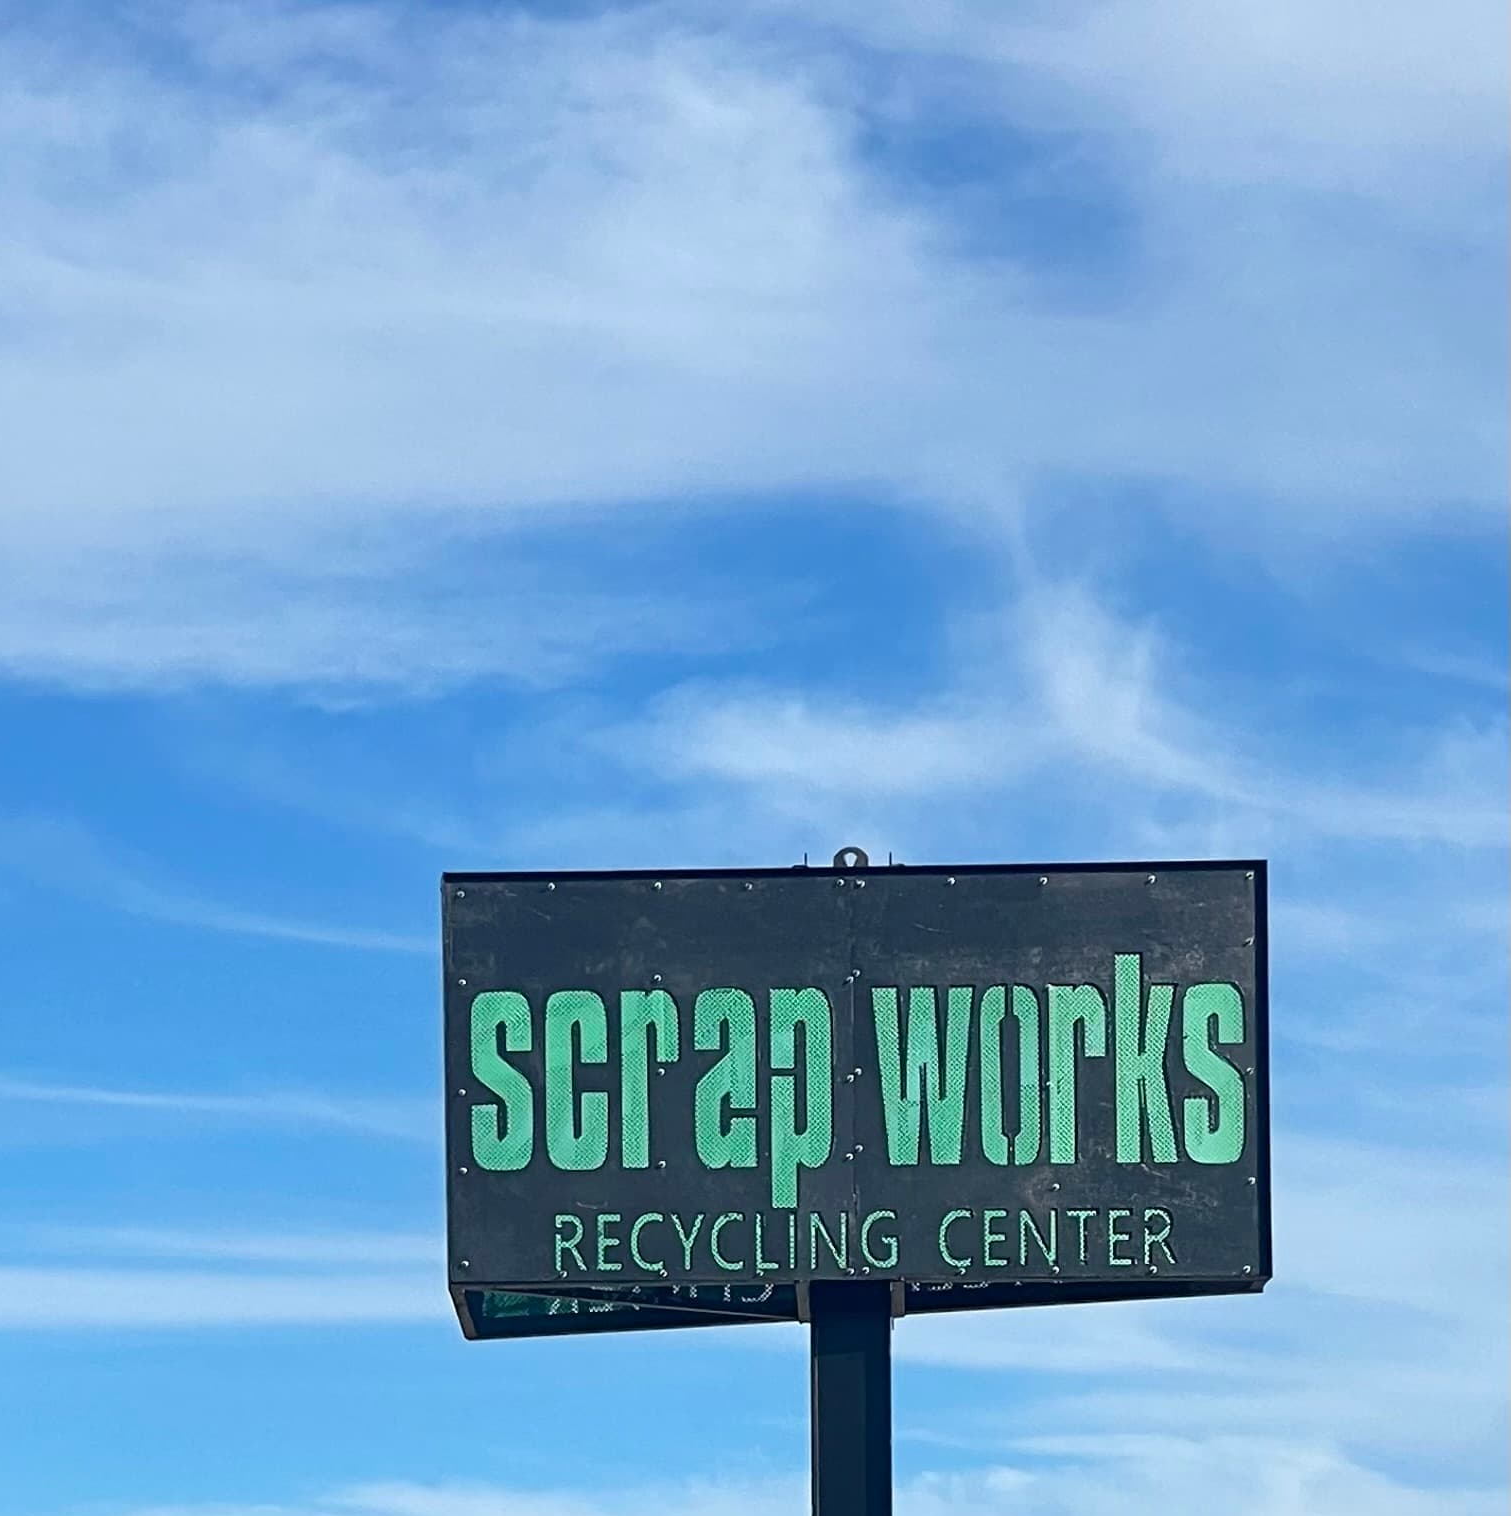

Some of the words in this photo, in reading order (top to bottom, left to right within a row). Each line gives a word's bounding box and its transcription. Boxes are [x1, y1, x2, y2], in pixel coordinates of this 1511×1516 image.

[470, 987, 834, 1209] scrap
[872, 952, 1247, 1166] works
[554, 1210, 900, 1273] RECYCLING
[939, 1207, 1177, 1268] CENTER
